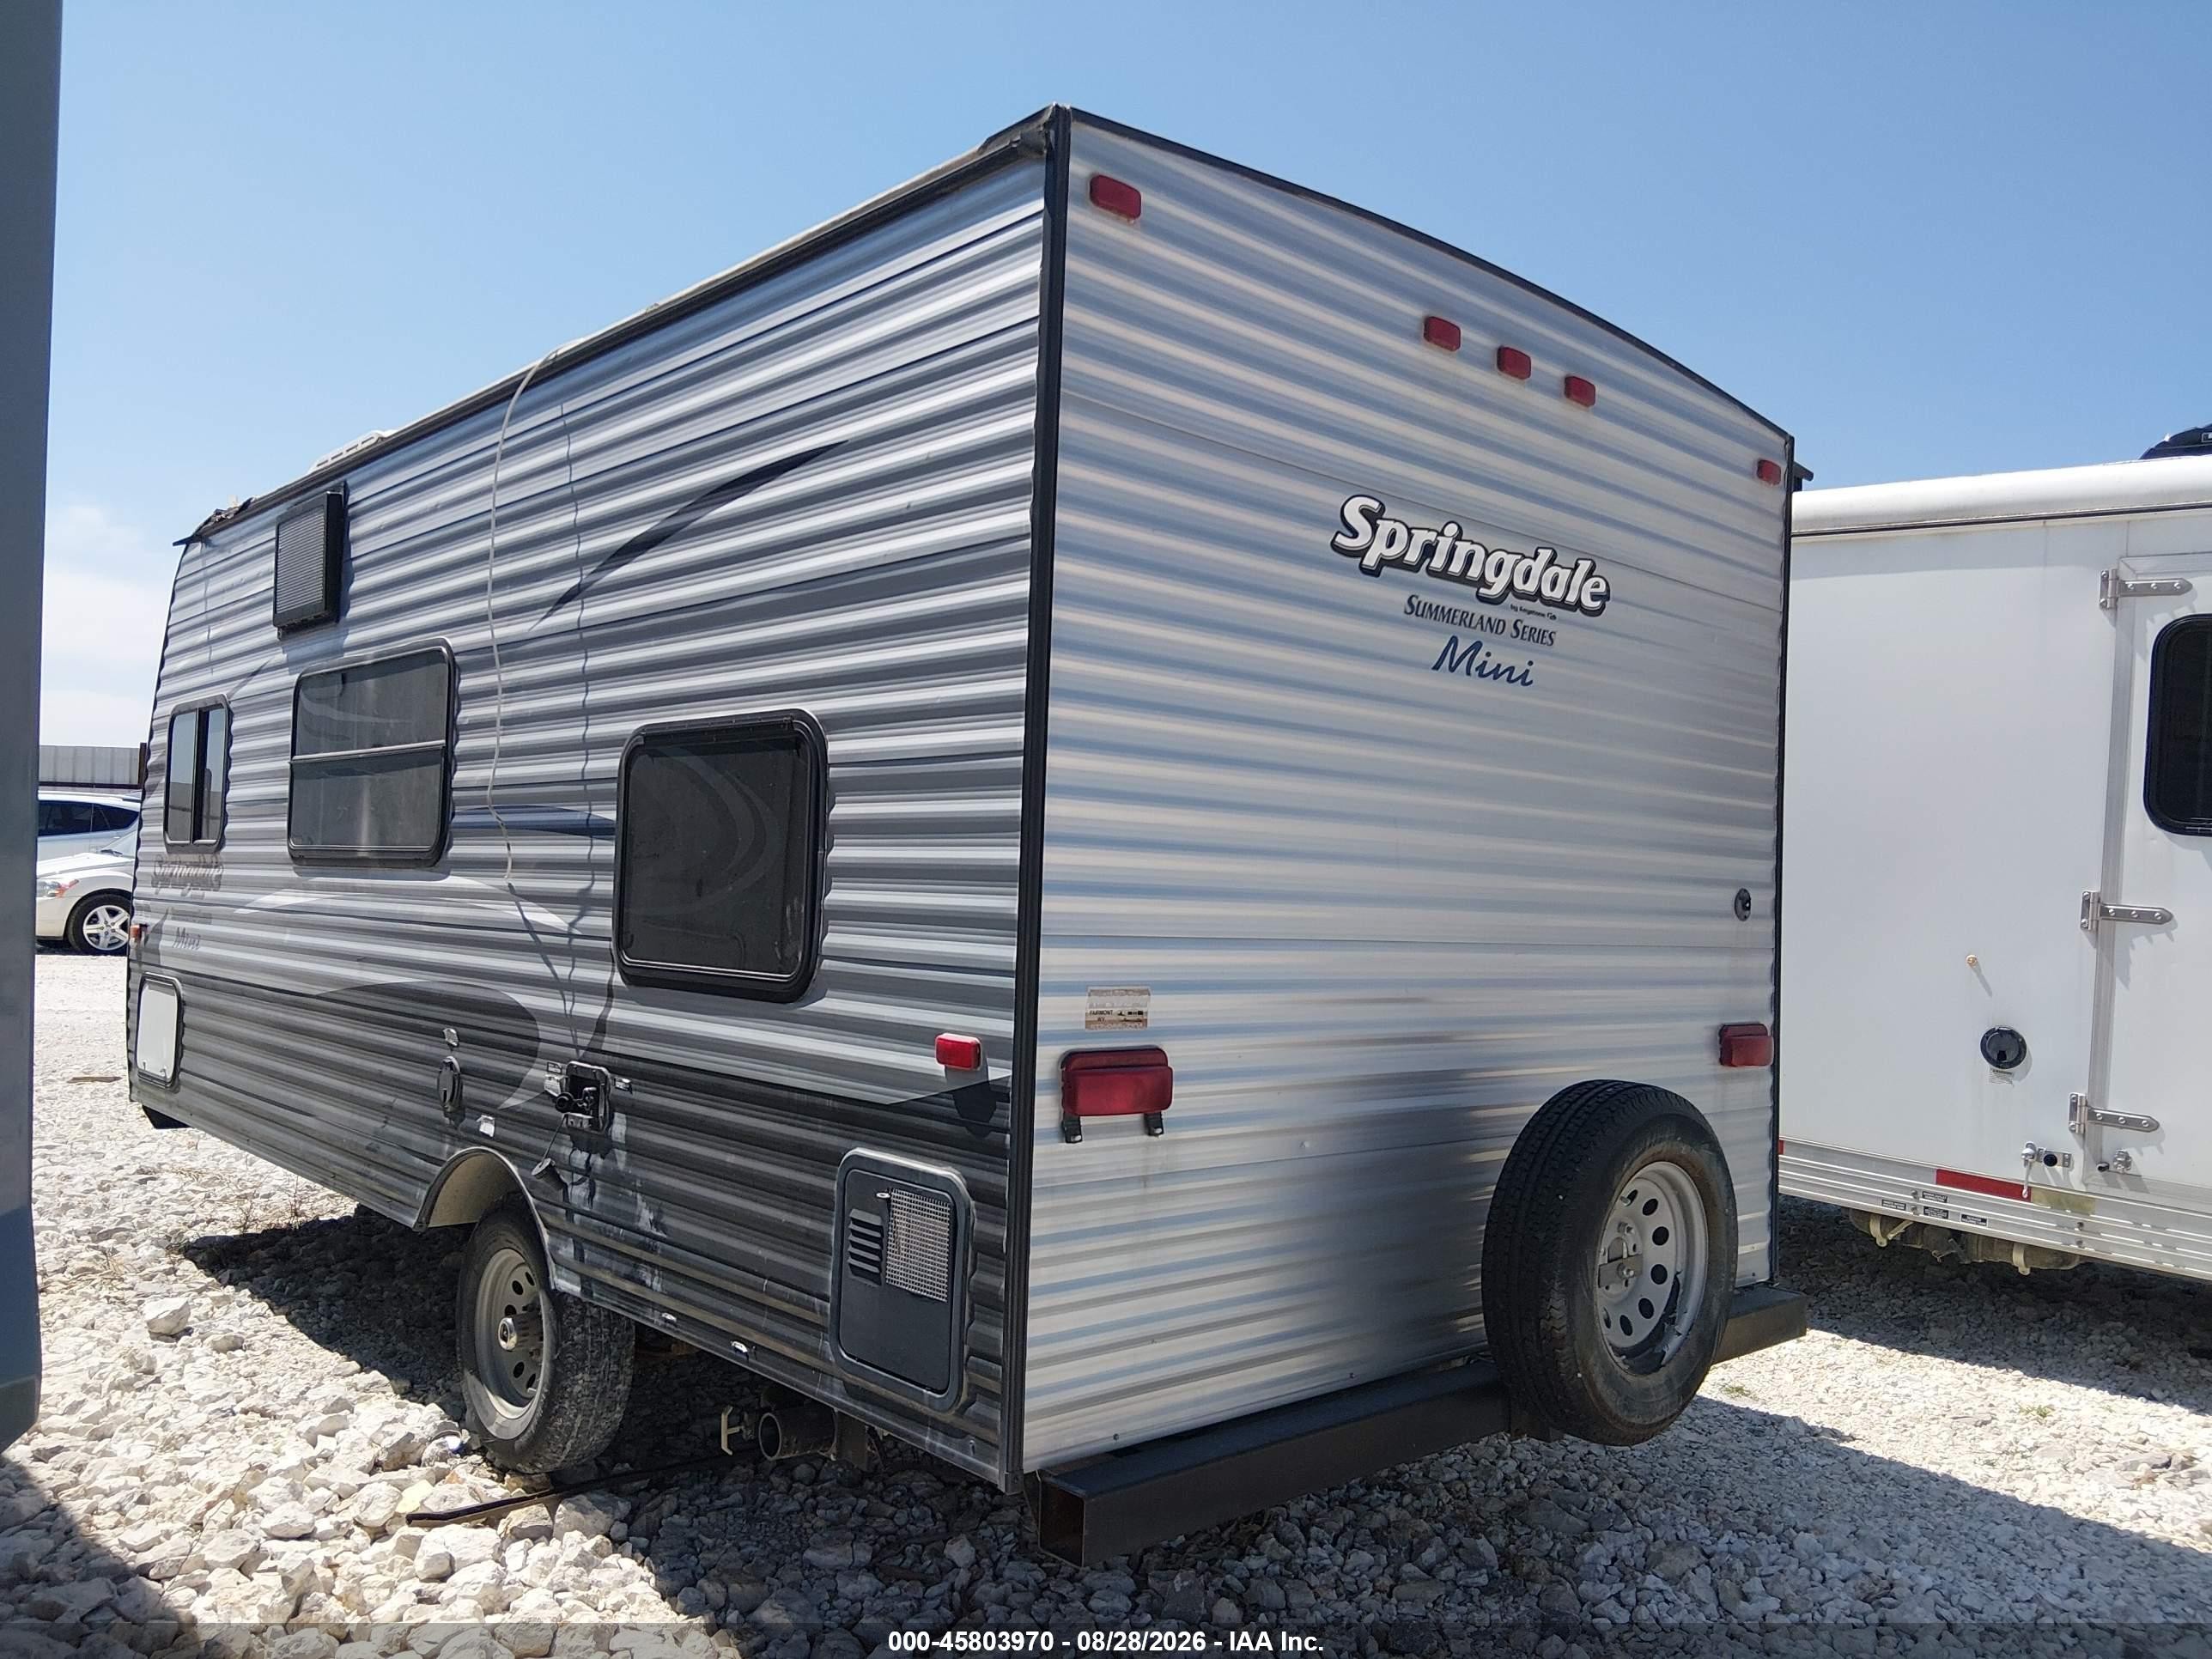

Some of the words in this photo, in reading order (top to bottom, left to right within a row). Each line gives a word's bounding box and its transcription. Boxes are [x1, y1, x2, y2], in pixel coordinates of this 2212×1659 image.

[1331, 494, 1611, 617] Springdale
[1404, 595, 1506, 636] SUMMERLAND
[1510, 619, 1557, 647] SERIES
[1431, 635, 1534, 686] Mini
